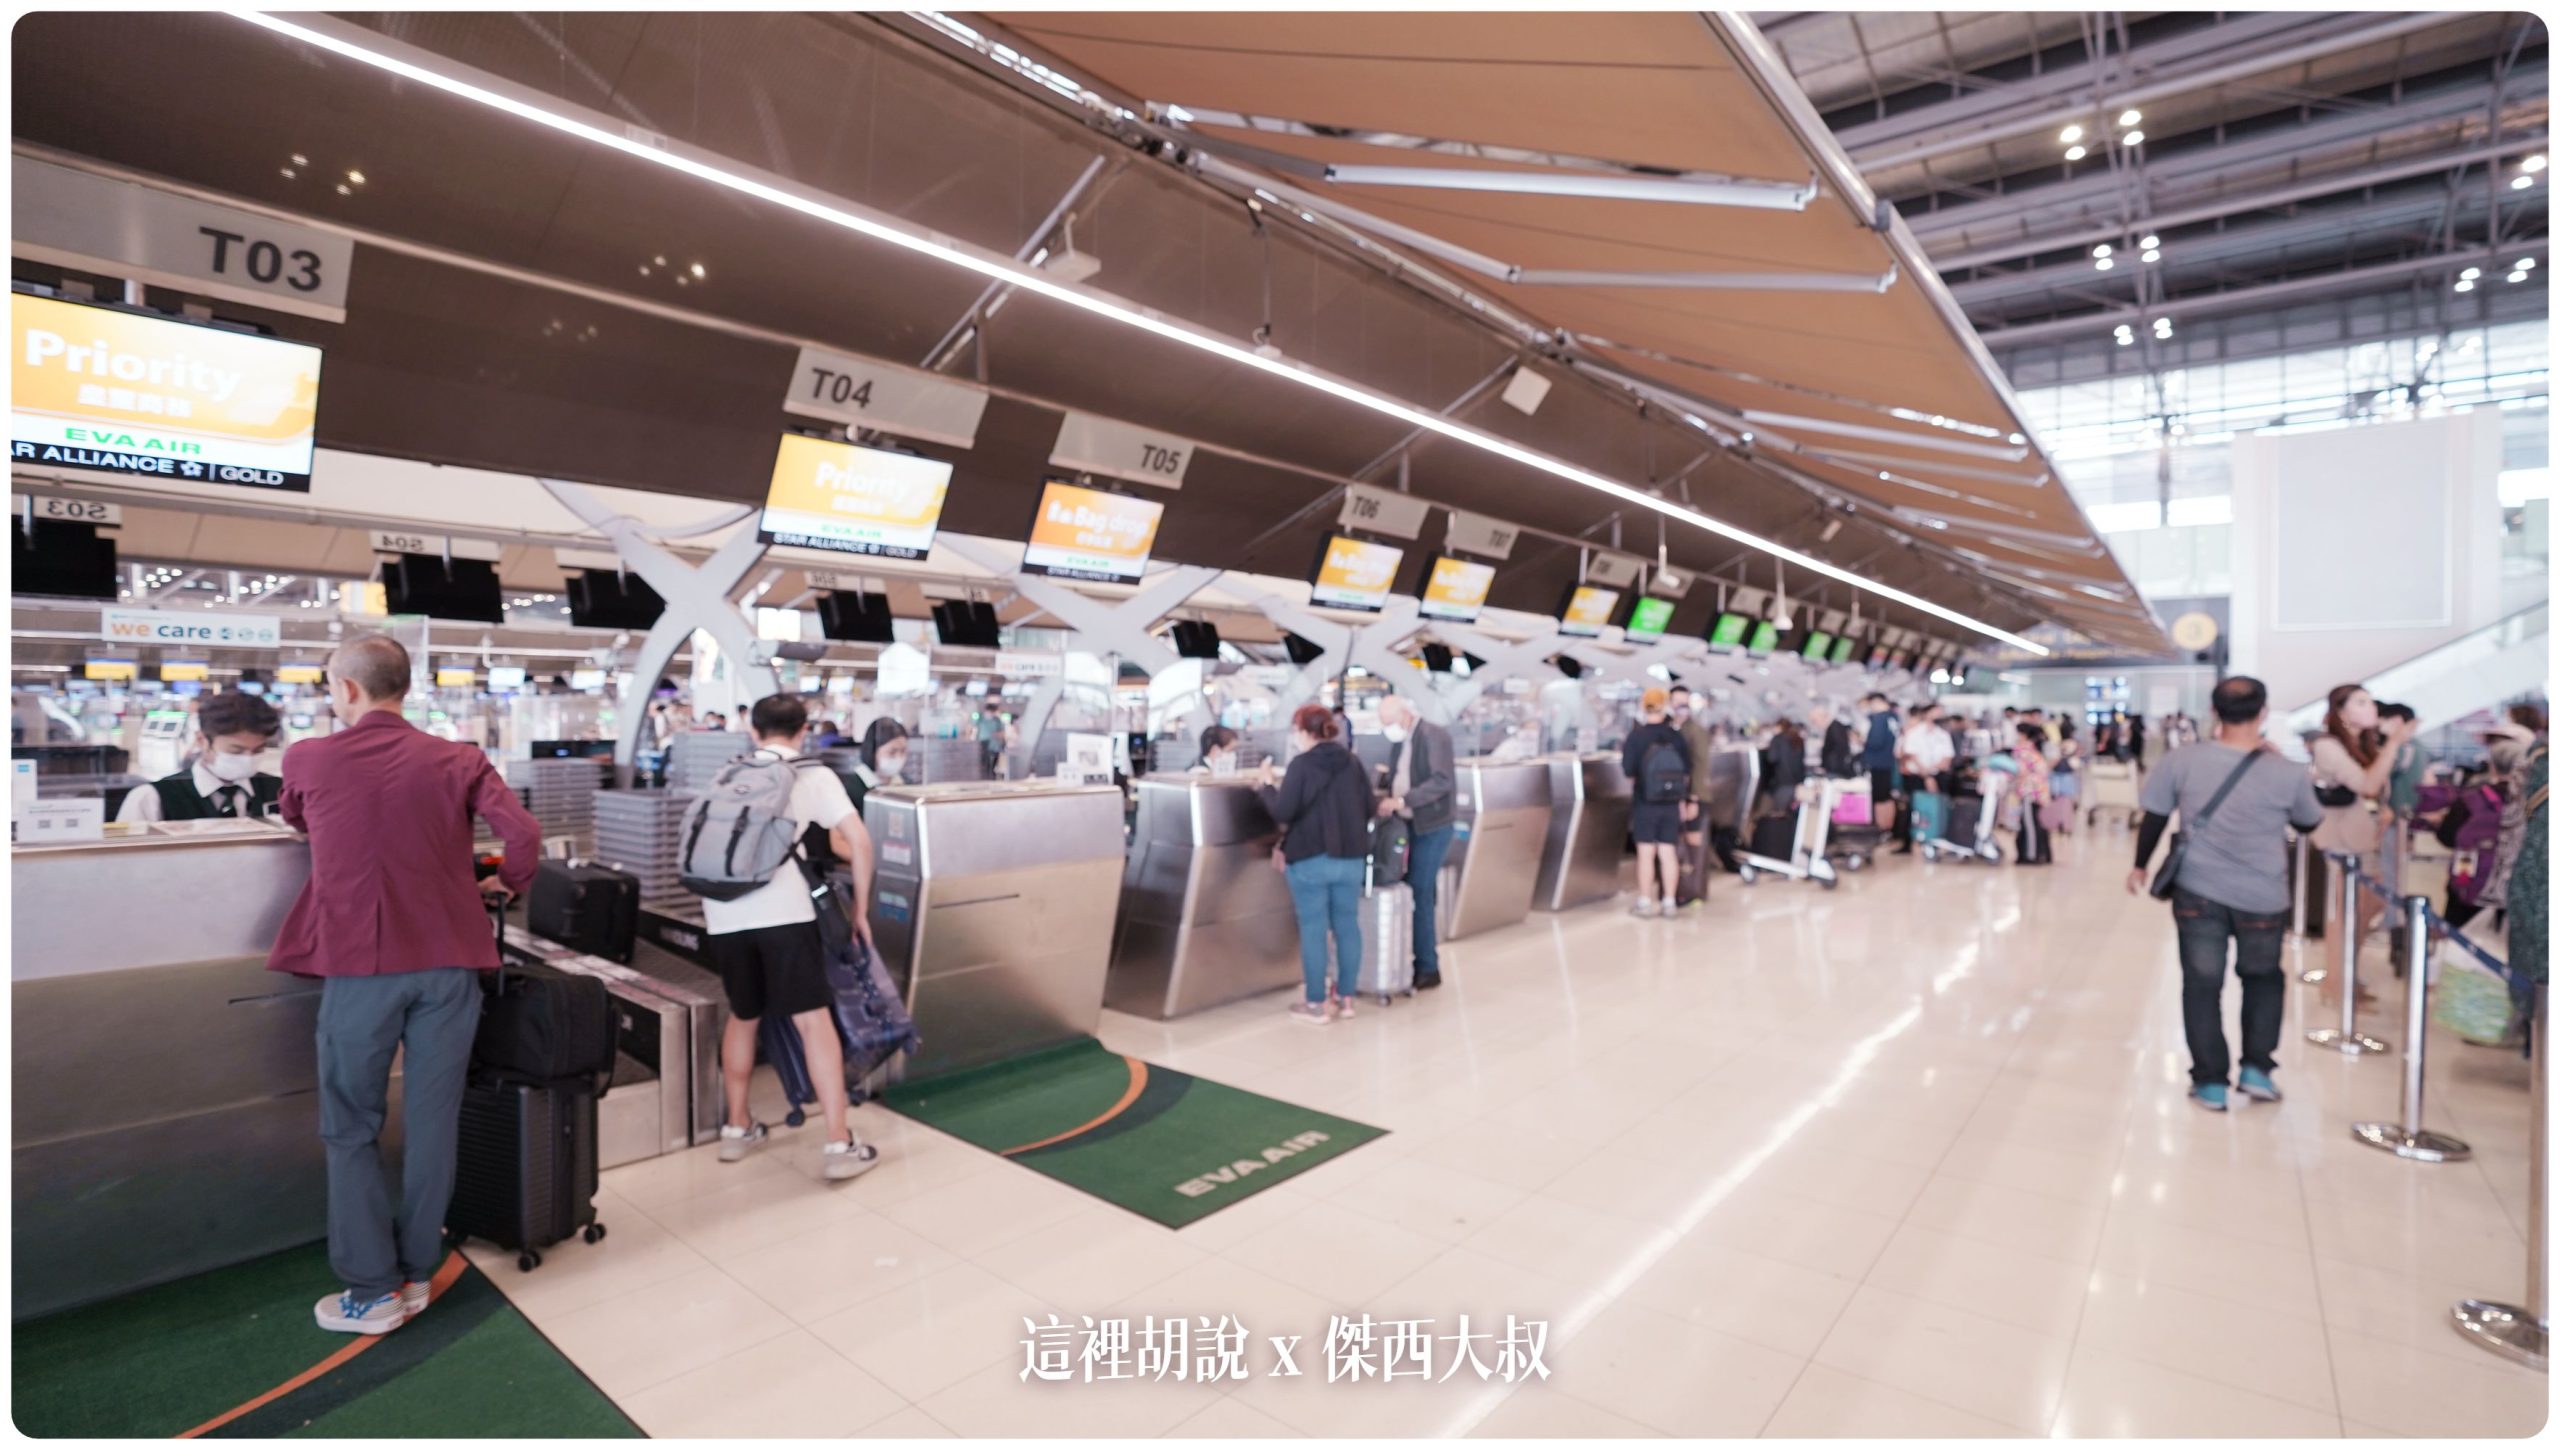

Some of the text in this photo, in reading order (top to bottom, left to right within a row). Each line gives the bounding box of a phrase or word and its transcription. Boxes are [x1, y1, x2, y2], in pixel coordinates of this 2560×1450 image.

[199, 226, 322, 292] T03
[25, 328, 241, 401] Priority
[811, 367, 874, 408] T04
[65, 428, 201, 454] EVA AIR
[1141, 444, 1182, 474] T05
[43, 446, 174, 474] ALLIANCE
[220, 465, 284, 486] GOLD
[111, 623, 212, 639] we care
[1174, 1130, 1331, 1198] EVA AIR
